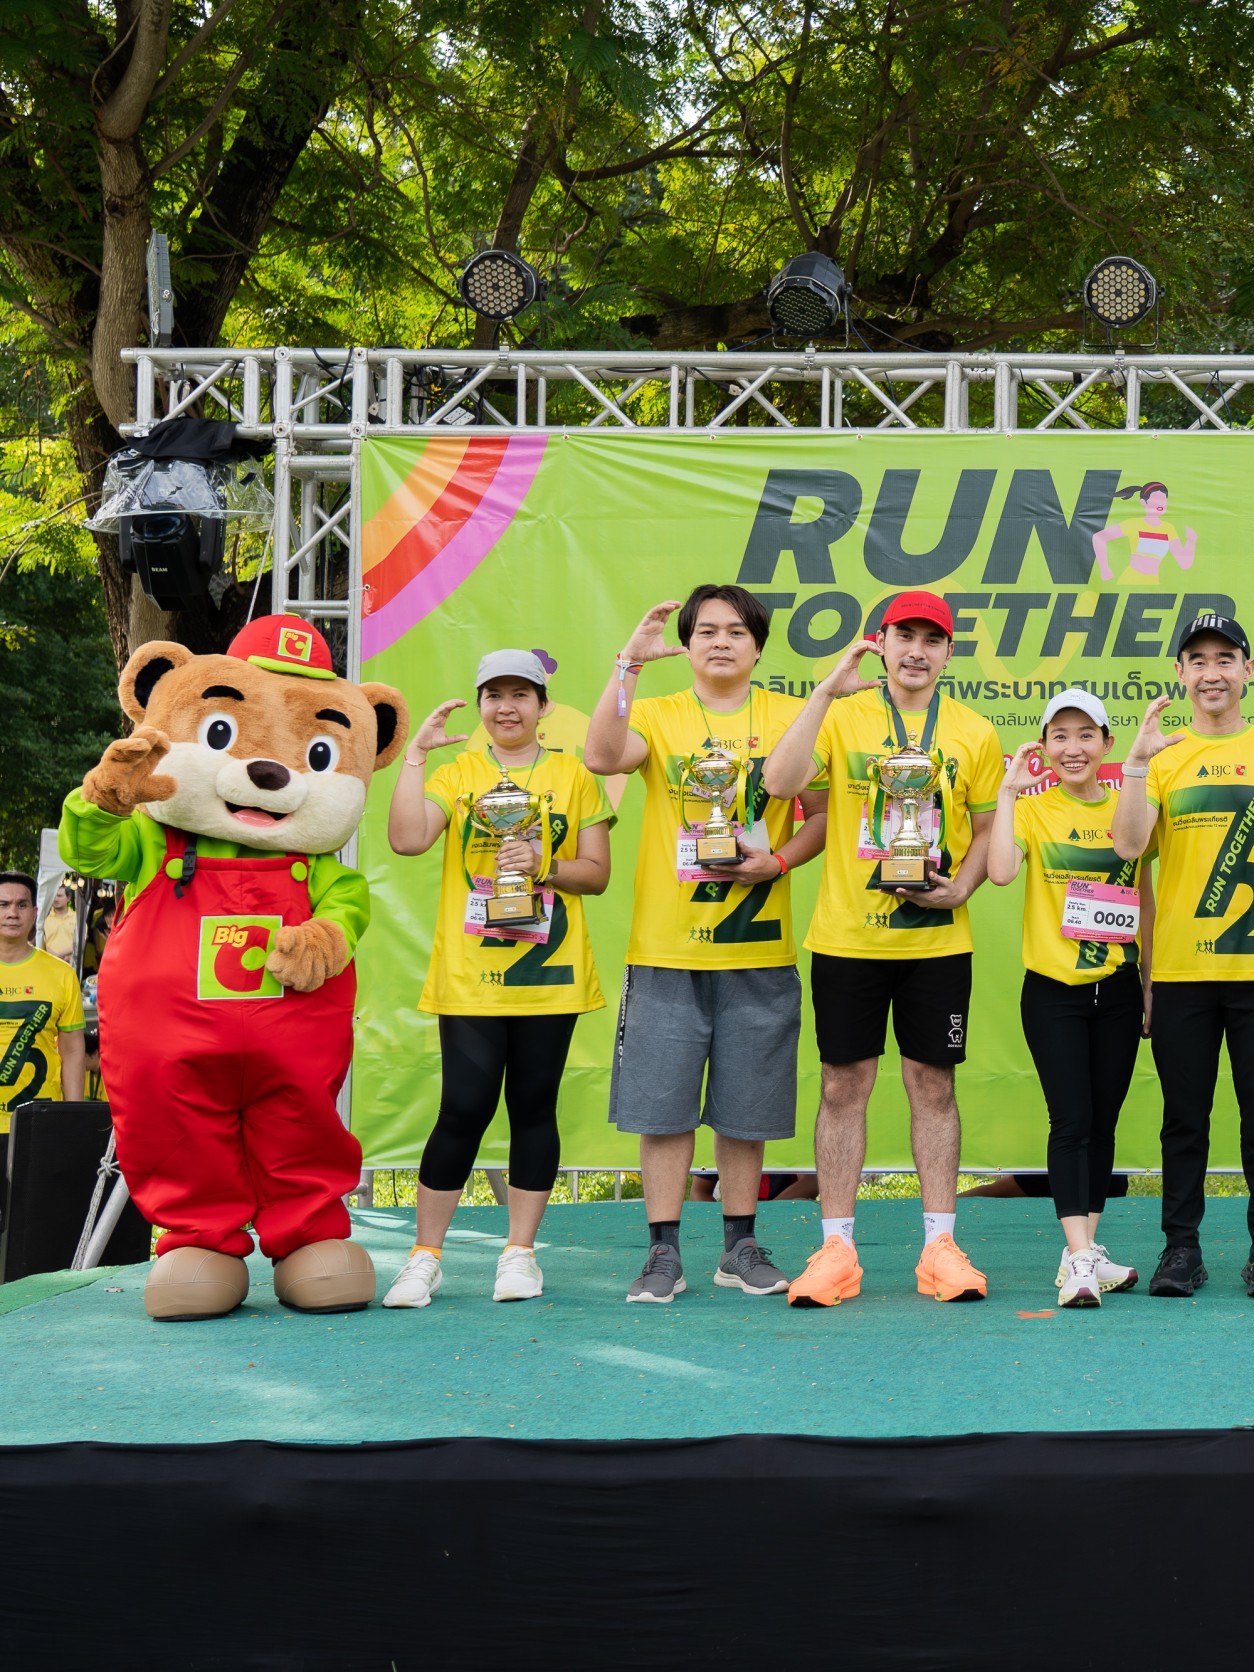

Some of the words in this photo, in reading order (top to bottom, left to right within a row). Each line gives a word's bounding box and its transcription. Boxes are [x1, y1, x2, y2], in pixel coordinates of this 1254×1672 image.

[736, 469, 1122, 586] RUN
[1211, 765, 1231, 778] BJC
[1083, 830, 1103, 842] BJC
[1071, 881, 1089, 889] RUN
[1205, 876, 1227, 913] RUN
[1093, 910, 1135, 929] 0002
[213, 925, 249, 948] Big
[0, 1057, 17, 1084] RUN
[12, 1004, 49, 1057] TOGETHER
